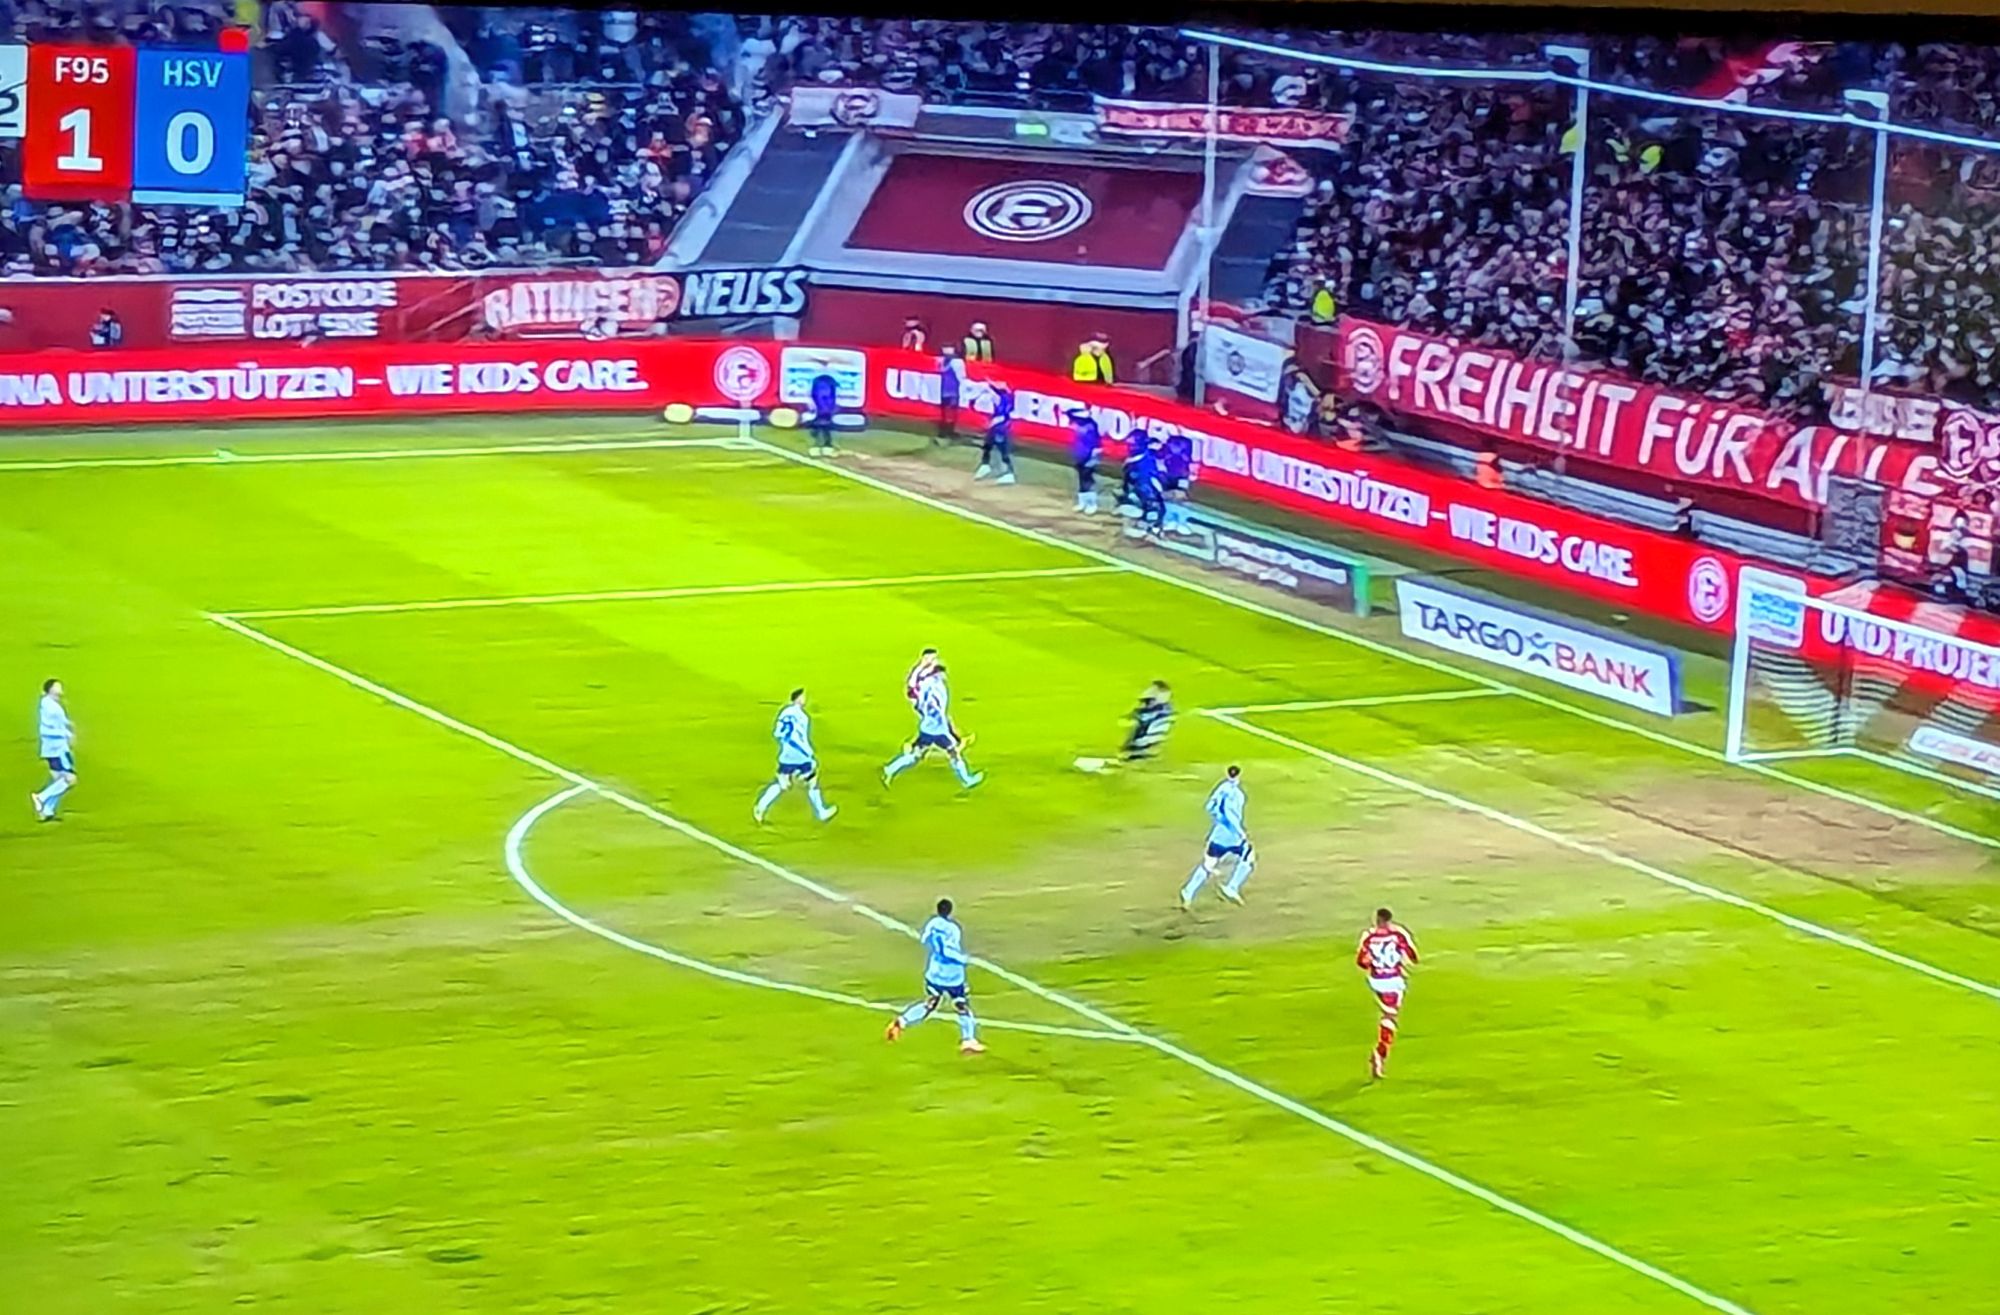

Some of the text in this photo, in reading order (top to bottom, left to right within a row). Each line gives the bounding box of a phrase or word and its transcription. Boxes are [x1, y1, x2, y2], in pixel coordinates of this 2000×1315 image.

[55, 57, 110, 83] F95
[163, 59, 224, 87] HSV
[57, 107, 103, 171] 1
[166, 111, 215, 174] 0
[680, 270, 806, 316] NEUSS
[68, 361, 353, 405] UNTERSTÜTZEN
[386, 364, 454, 395] WIE
[457, 361, 541, 394] KIDS
[543, 358, 650, 392] CARE.
[1388, 334, 1637, 456] FREIHEIT
[1637, 394, 1754, 484] FÜR
[1251, 447, 1430, 528] UNTERSTÜTZEN
[1449, 503, 1497, 547] WIE
[1498, 516, 1559, 565] KIDS
[1560, 535, 1640, 588] CARE.
